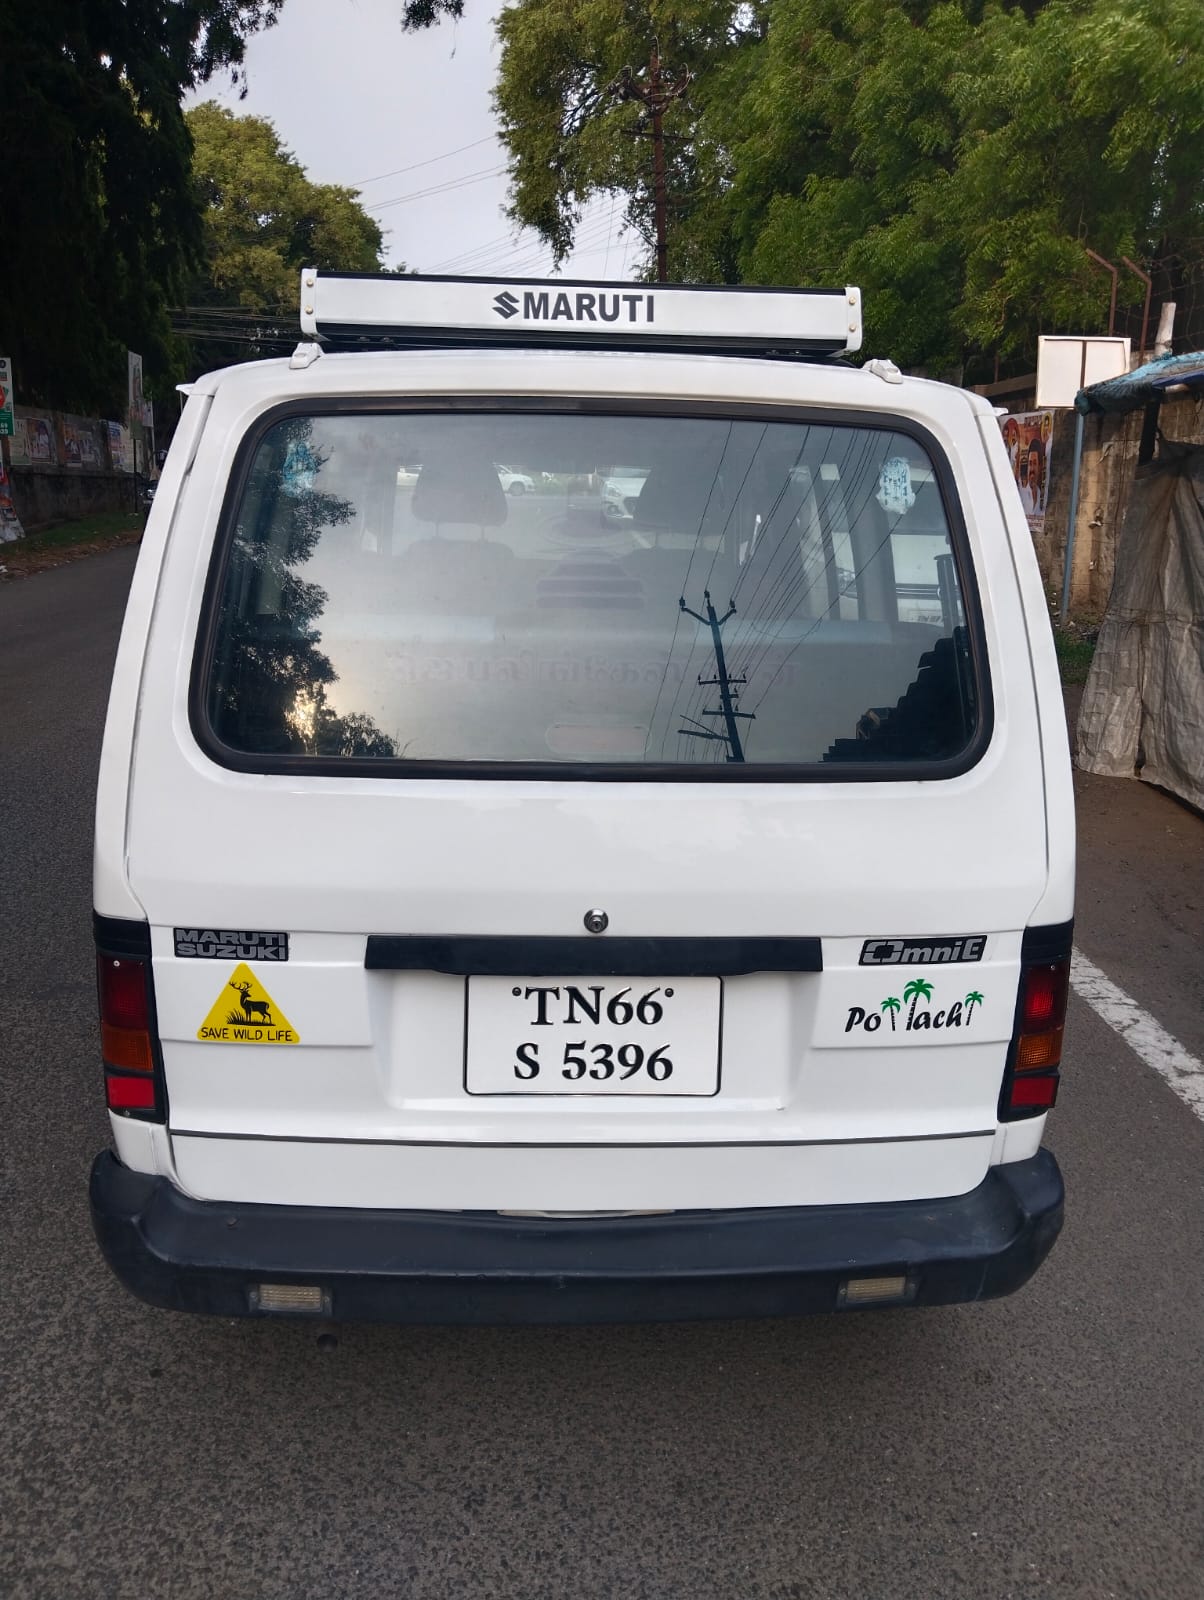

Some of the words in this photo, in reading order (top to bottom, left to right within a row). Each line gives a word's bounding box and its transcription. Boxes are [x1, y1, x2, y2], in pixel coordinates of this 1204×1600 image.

[524, 292, 655, 322] MARUTI
[175, 930, 286, 946] MARUTI
[176, 944, 286, 960] SUZUKI
[525, 986, 663, 1026] TN66
[200, 1027, 230, 1040] SAVE
[234, 1028, 263, 1041] WILD
[268, 1030, 293, 1042] LIFE
[514, 1042, 540, 1081] S
[561, 1040, 673, 1081] 5396
